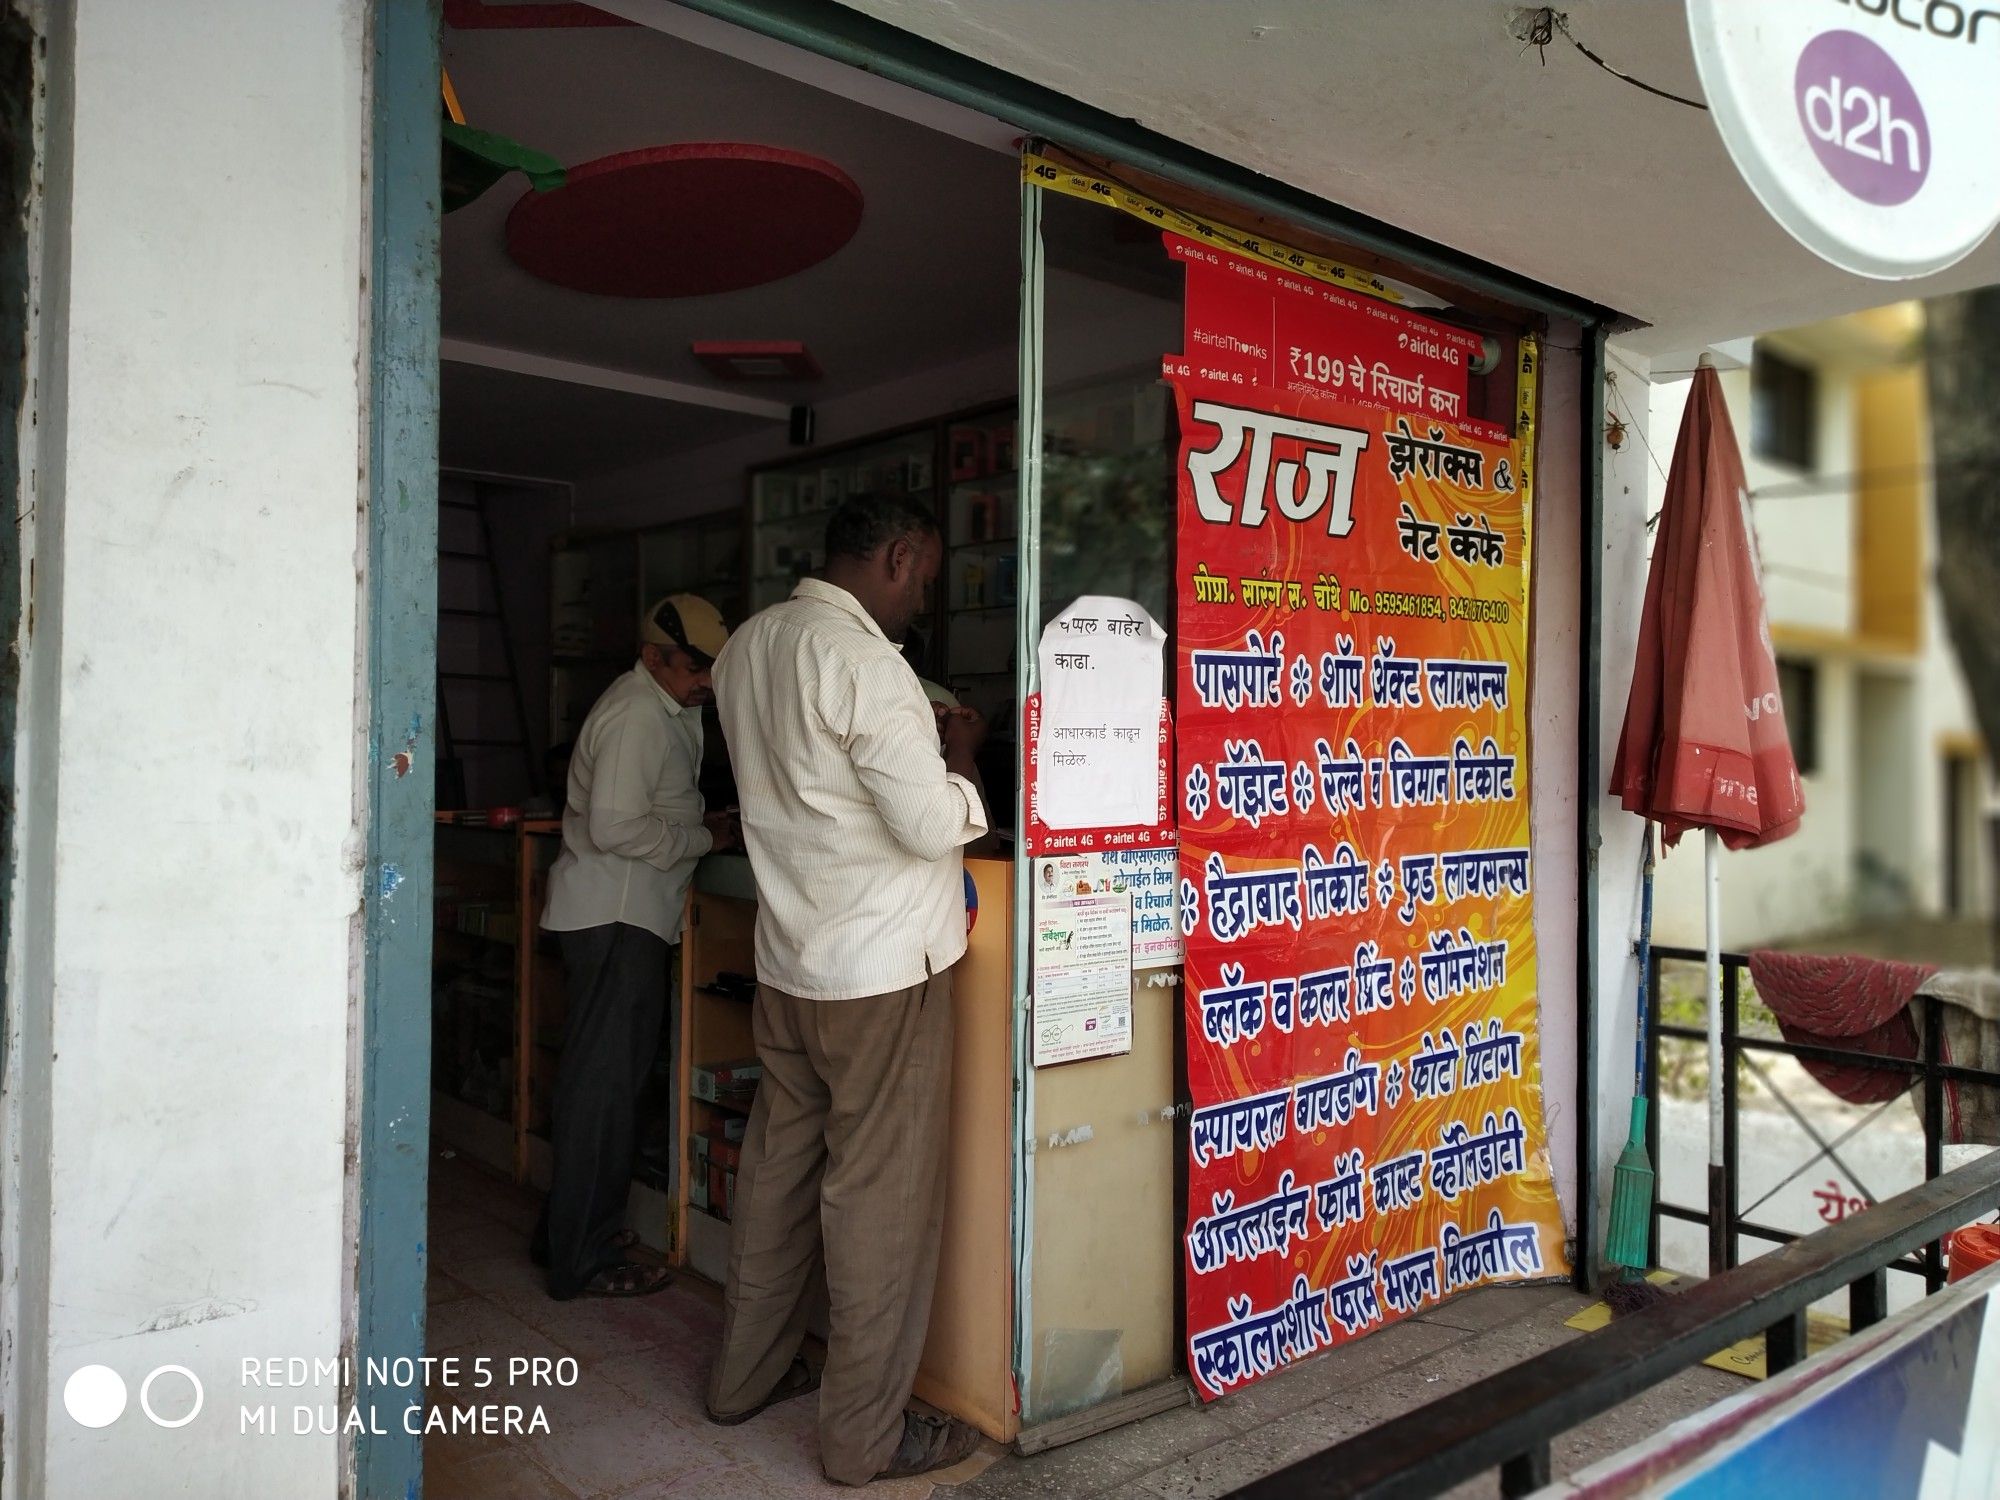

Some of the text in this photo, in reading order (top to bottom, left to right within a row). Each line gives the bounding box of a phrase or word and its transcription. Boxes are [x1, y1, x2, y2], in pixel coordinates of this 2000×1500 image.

[1804, 76, 1920, 172] d2h
[1033, 164, 1056, 180] 4G
[1090, 181, 1111, 197] 4G
[1184, 245, 1219, 266] airtel 4G
[1235, 262, 1268, 282] airtel 4G
[1283, 279, 1315, 297] airtel 4G
[1328, 294, 1358, 312] airtel 4G
[1409, 336, 1460, 367] airtel 4G
[1522, 353, 1533, 375] 4G
[1177, 366, 1191, 377] 4G
[1208, 369, 1244, 385] airtel 4G
[1289, 345, 1346, 388] ₹199
[1347, 354, 1368, 394] चे
[1369, 362, 1425, 409] रिचार्ज
[1427, 385, 1461, 419] करा
[1187, 401, 1369, 538] राज
[1384, 418, 1516, 494] झेरॉक्स &
[1397, 503, 1505, 567] नेट कॅफे
[1241, 567, 1283, 609] सारंग
[1287, 582, 1308, 611] स.
[1349, 589, 1372, 613] Mo.
[1375, 591, 1447, 622] 9595461854,
[1107, 614, 1145, 637] बाहेर
[1054, 653, 1096, 670] काढा.
[1192, 629, 1285, 712] पासपोर्ट
[1321, 633, 1363, 708] शॉप
[1031, 710, 1040, 742] airtel
[1053, 724, 1141, 744] आधारकार्ड काढून
[1159, 727, 1167, 743] 4G
[1053, 750, 1092, 767] मिळेल.
[1159, 770, 1167, 821] airtel 4G
[1216, 739, 1289, 828] गॅझेट
[1315, 737, 1365, 817] रेल्वे
[1387, 736, 1452, 807] विमान
[1455, 736, 1517, 804] टिकीट
[1031, 794, 1039, 826] airtel
[1053, 833, 1094, 848] airtel 4G
[1112, 831, 1150, 844] airtel 4G
[1153, 866, 1173, 886] सिम
[1135, 888, 1174, 911] व रिचार्ज
[1206, 852, 1301, 943] हैद्राबाद
[1303, 841, 1370, 921] तिकीट
[1440, 847, 1531, 905] लायसन्स
[1140, 913, 1174, 934] मिळेल.
[1269, 978, 1295, 1033] व
[1298, 966, 1352, 1027] कलर
[1354, 940, 1395, 1015] प्रिंट
[1191, 1087, 1293, 1167] स्पायरल
[1187, 1168, 1312, 1275] ऑनलाईन
[1315, 1147, 1365, 1232] फॉर्म
[1370, 1149, 1426, 1215] कास्ट
[1191, 1272, 1333, 1395] स्कॉलरशीप
[1329, 1247, 1383, 1335] फॉर्म
[1441, 1206, 1544, 1294] मिळतील
